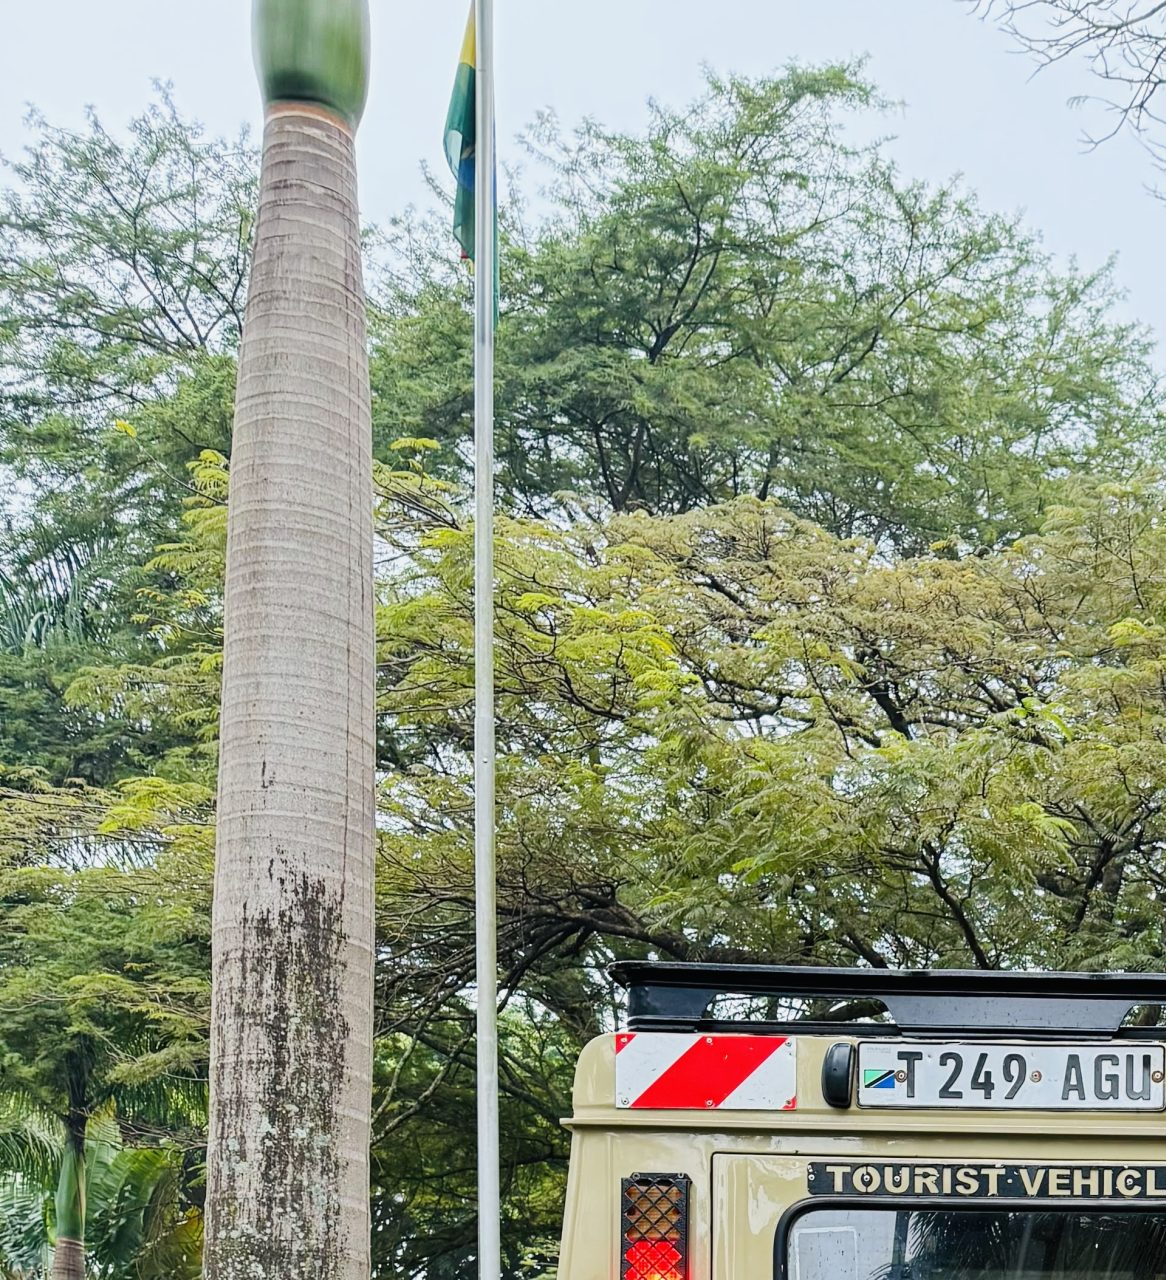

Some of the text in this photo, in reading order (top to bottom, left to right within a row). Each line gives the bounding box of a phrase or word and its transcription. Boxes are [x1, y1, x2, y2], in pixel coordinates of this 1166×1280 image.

[897, 1051, 1151, 1101] T 249 AGU
[825, 1165, 1006, 1197] TOURIST
